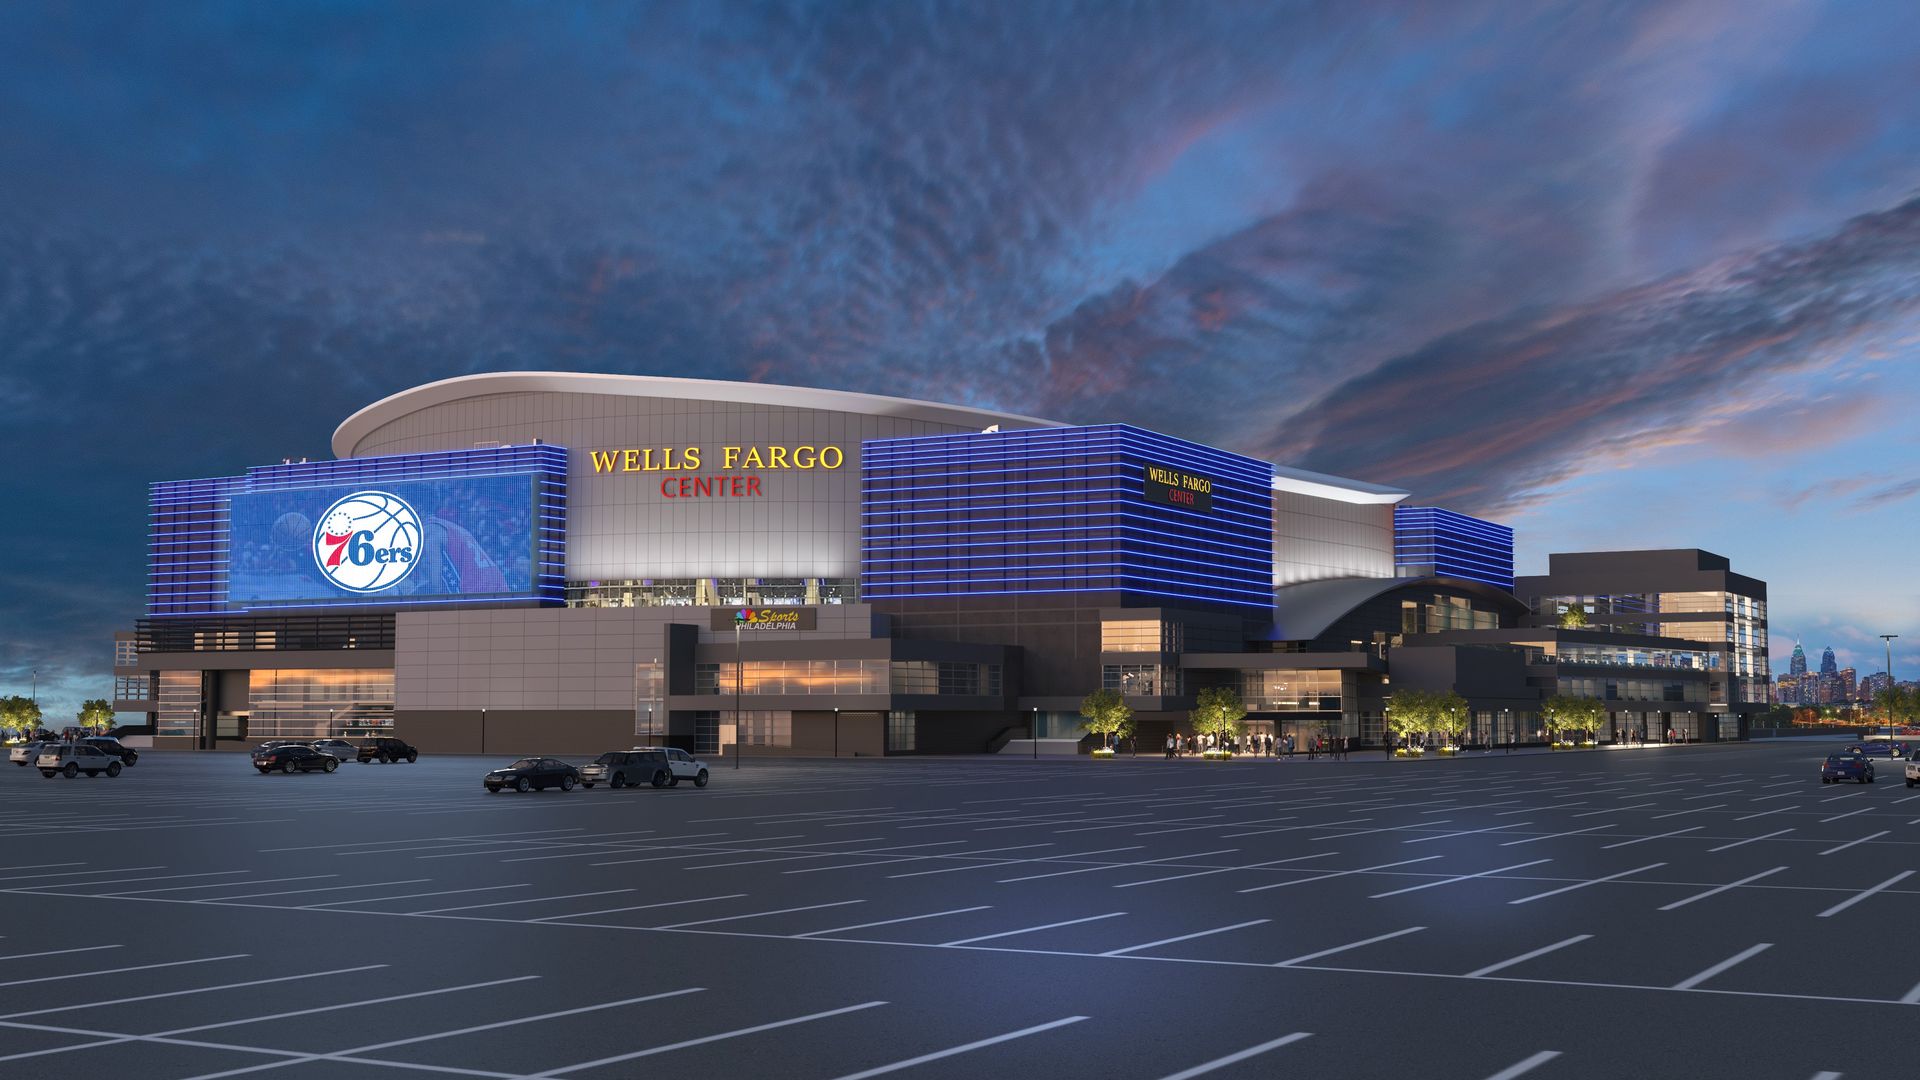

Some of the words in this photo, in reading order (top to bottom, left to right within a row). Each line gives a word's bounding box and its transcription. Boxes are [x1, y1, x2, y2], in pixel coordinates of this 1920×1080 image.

[590, 447, 701, 473] WELLS
[722, 445, 844, 470] FARGO
[661, 476, 763, 498] CENTER
[1149, 466, 1179, 487] WELLS
[1183, 474, 1211, 494] FARGO
[1168, 488, 1194, 505] CENTER
[325, 529, 413, 568] 76ers
[758, 609, 799, 624] Sports
